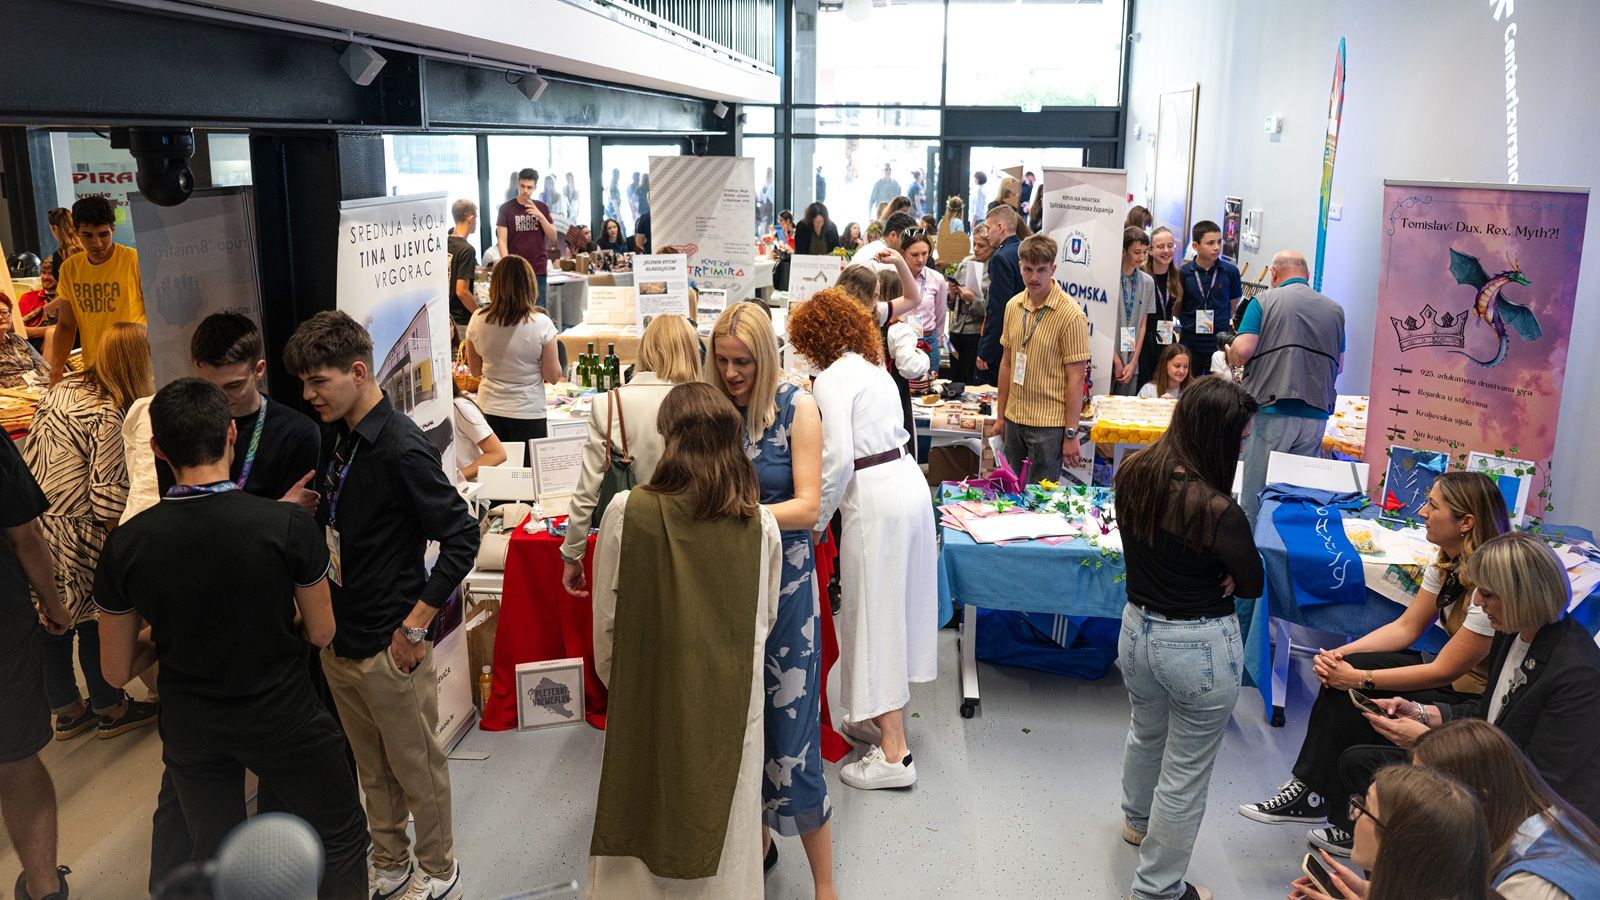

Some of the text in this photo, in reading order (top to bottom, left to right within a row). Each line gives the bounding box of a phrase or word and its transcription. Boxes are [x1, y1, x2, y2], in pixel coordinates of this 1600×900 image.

[72, 172, 134, 184] PIRA
[350, 213, 445, 244] SREDNJA ŠKOLA
[1401, 217, 1560, 241] Tomislav: Dux. Rex. Myth?!
[360, 233, 442, 269] TINA UJEVIĆA
[374, 260, 432, 288] VRGORAC
[687, 264, 745, 278] TRPIMIRA
[1057, 280, 1108, 303] NOMSKA
